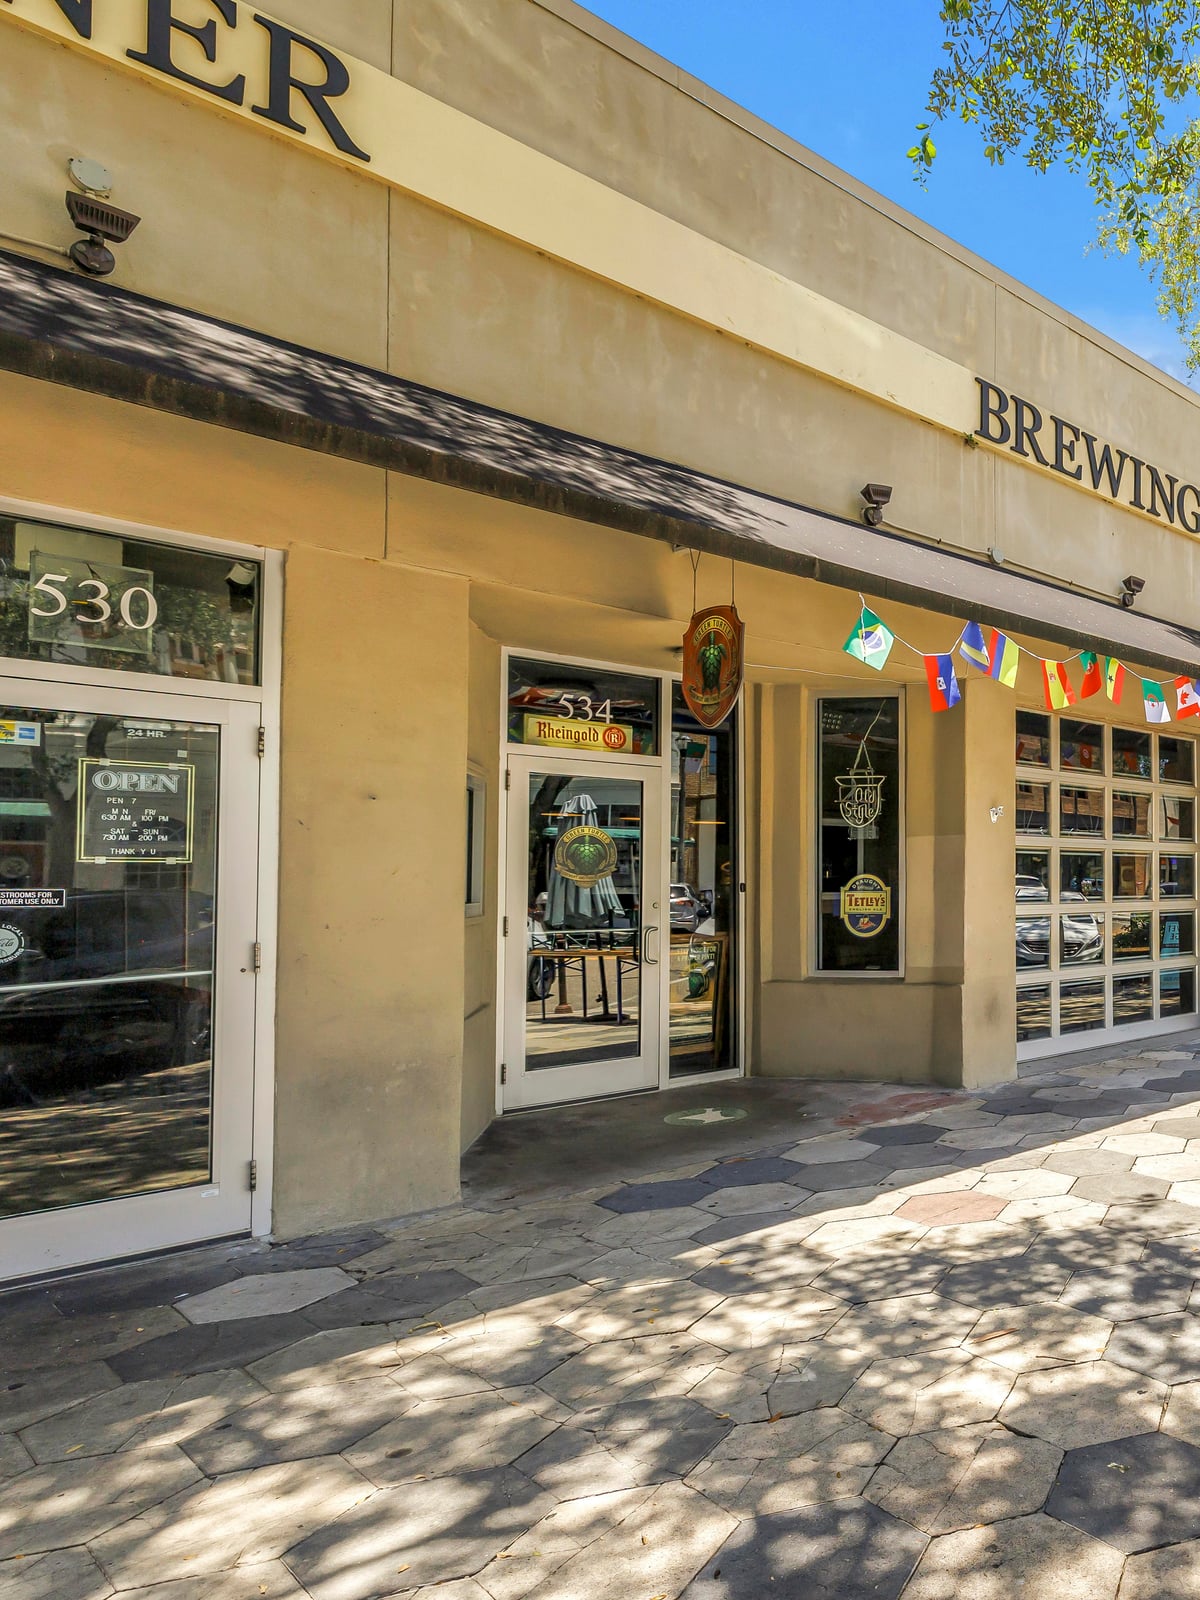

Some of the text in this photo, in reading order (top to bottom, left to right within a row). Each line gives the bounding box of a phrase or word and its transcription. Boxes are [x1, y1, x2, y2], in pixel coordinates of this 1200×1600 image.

[29, 573, 159, 630] 530
[694, 619, 733, 643] GREEN TURTLE
[558, 693, 614, 725] 534
[536, 721, 600, 743] Rheingold
[92, 770, 180, 793] OPEN
[845, 801, 874, 824] Style
[565, 828, 585, 840] GREEN
[851, 879, 881, 889] DRAUGHT
[40, 897, 60, 905] ONLY
